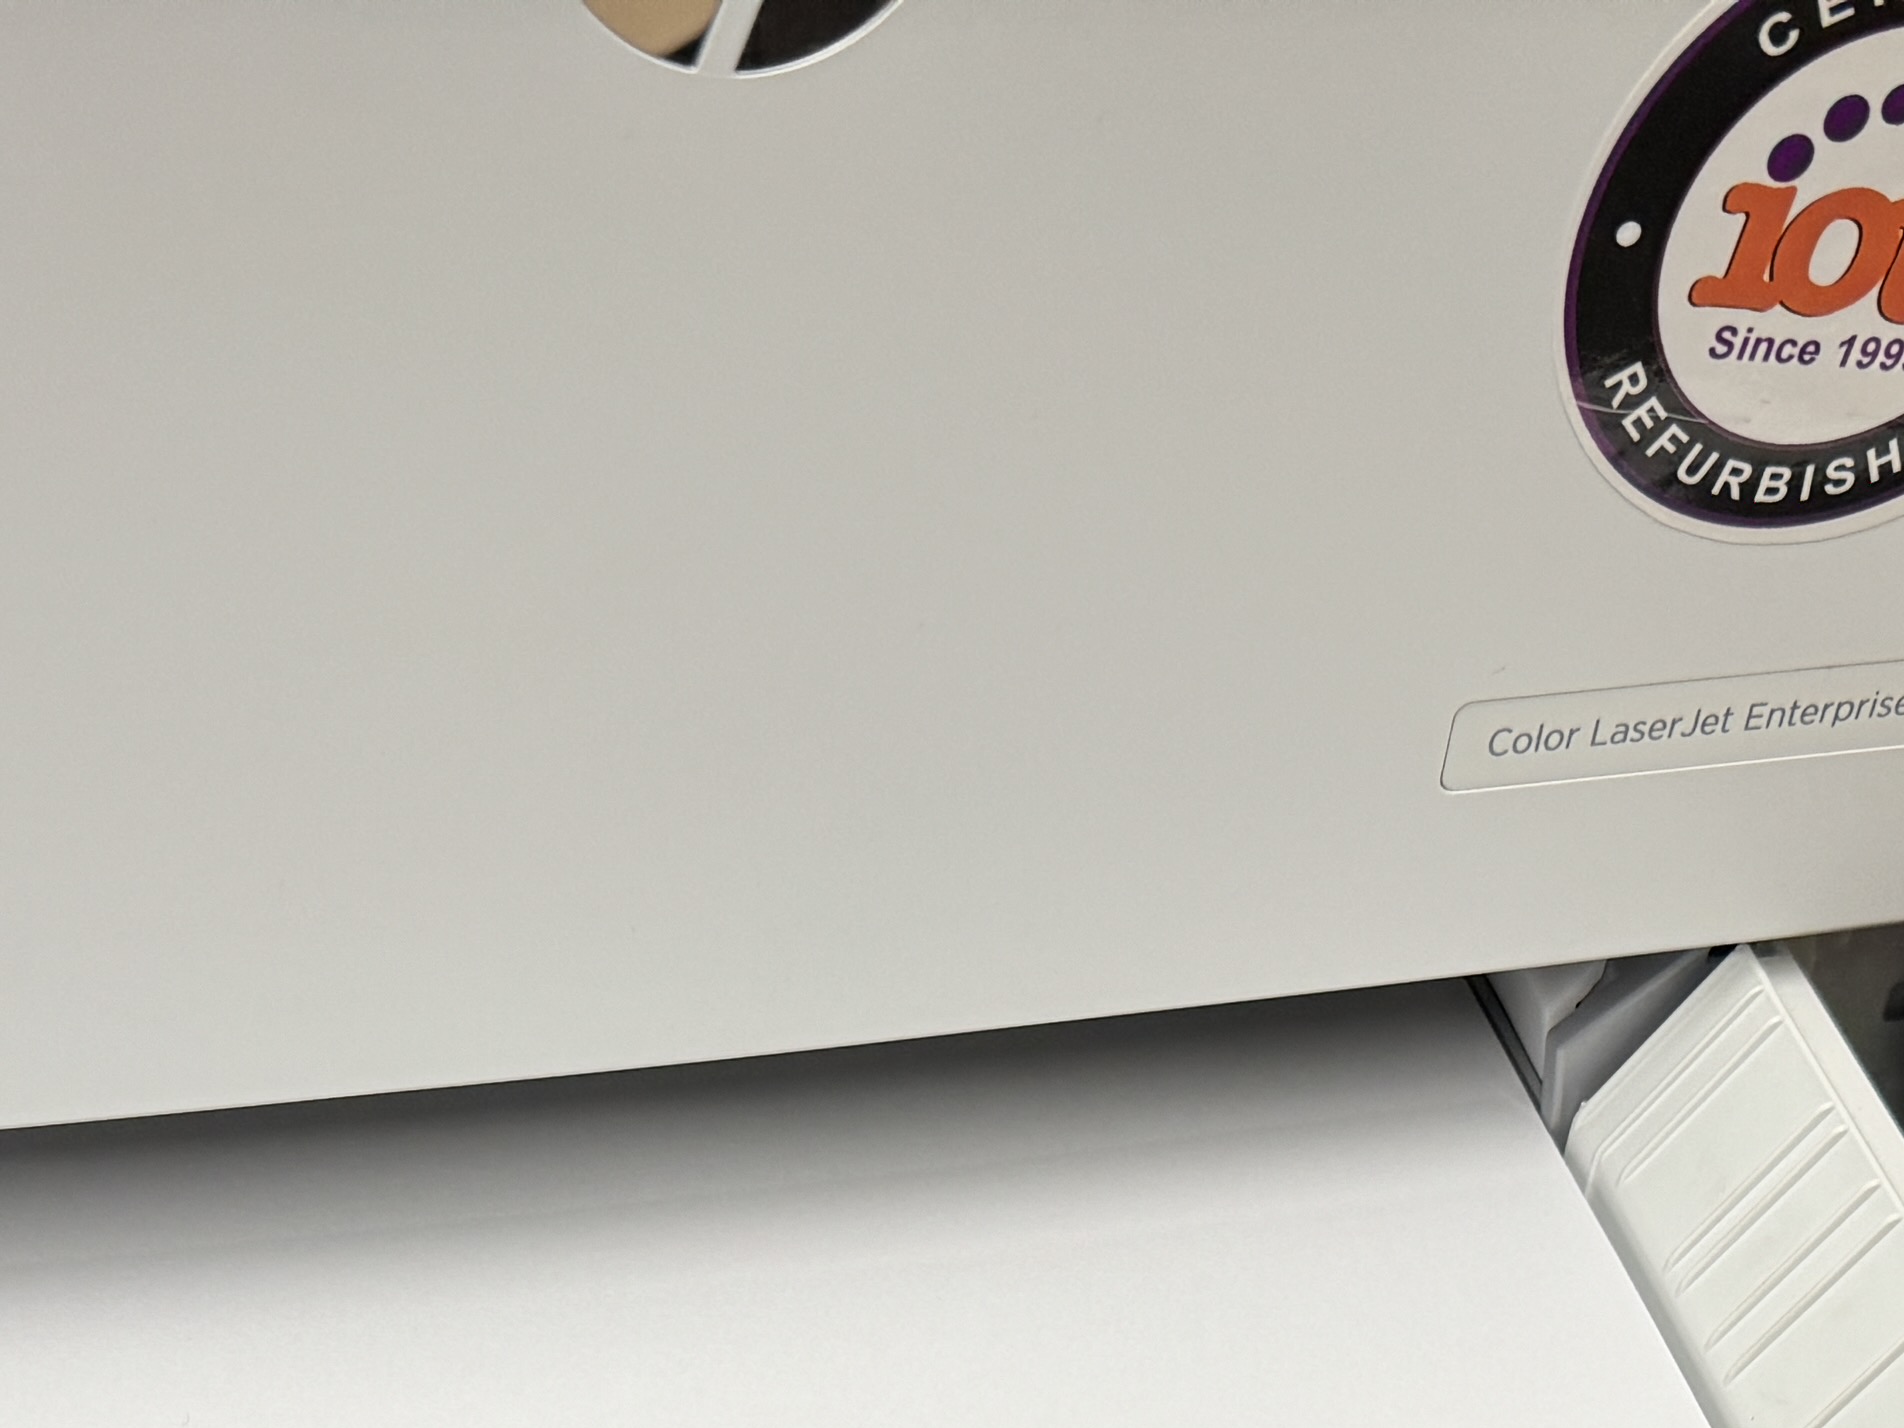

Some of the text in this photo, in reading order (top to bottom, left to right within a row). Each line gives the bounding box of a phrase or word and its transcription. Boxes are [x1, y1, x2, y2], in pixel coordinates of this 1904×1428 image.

[1708, 325, 1822, 368] Since
[1487, 727, 1579, 758] Color
[1589, 706, 1734, 748] LaserJet
